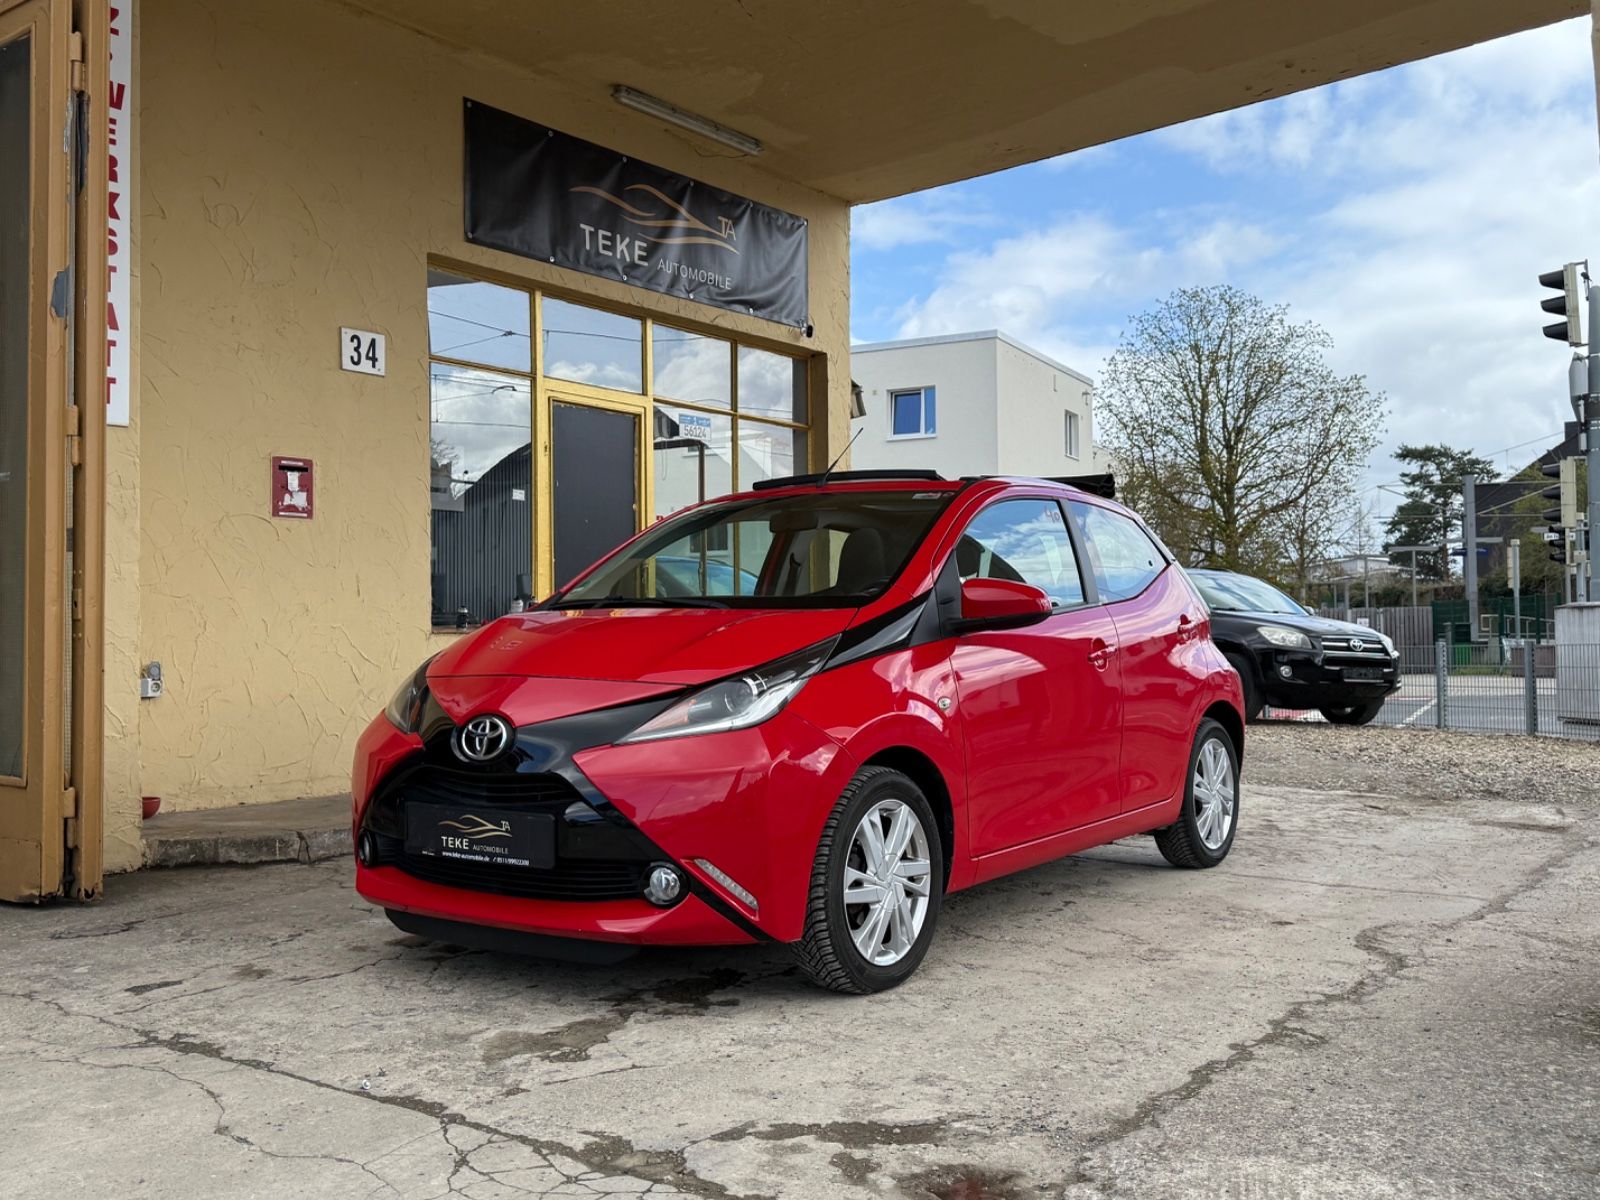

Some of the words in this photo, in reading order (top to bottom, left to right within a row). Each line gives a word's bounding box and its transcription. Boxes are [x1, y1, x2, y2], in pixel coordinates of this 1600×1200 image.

[580, 223, 649, 267] TEKE
[657, 258, 732, 291] AUTOMOBILE
[350, 334, 378, 369] 34
[441, 836, 470, 850] TEKE
[472, 844, 509, 854] AUTOMOBILE
